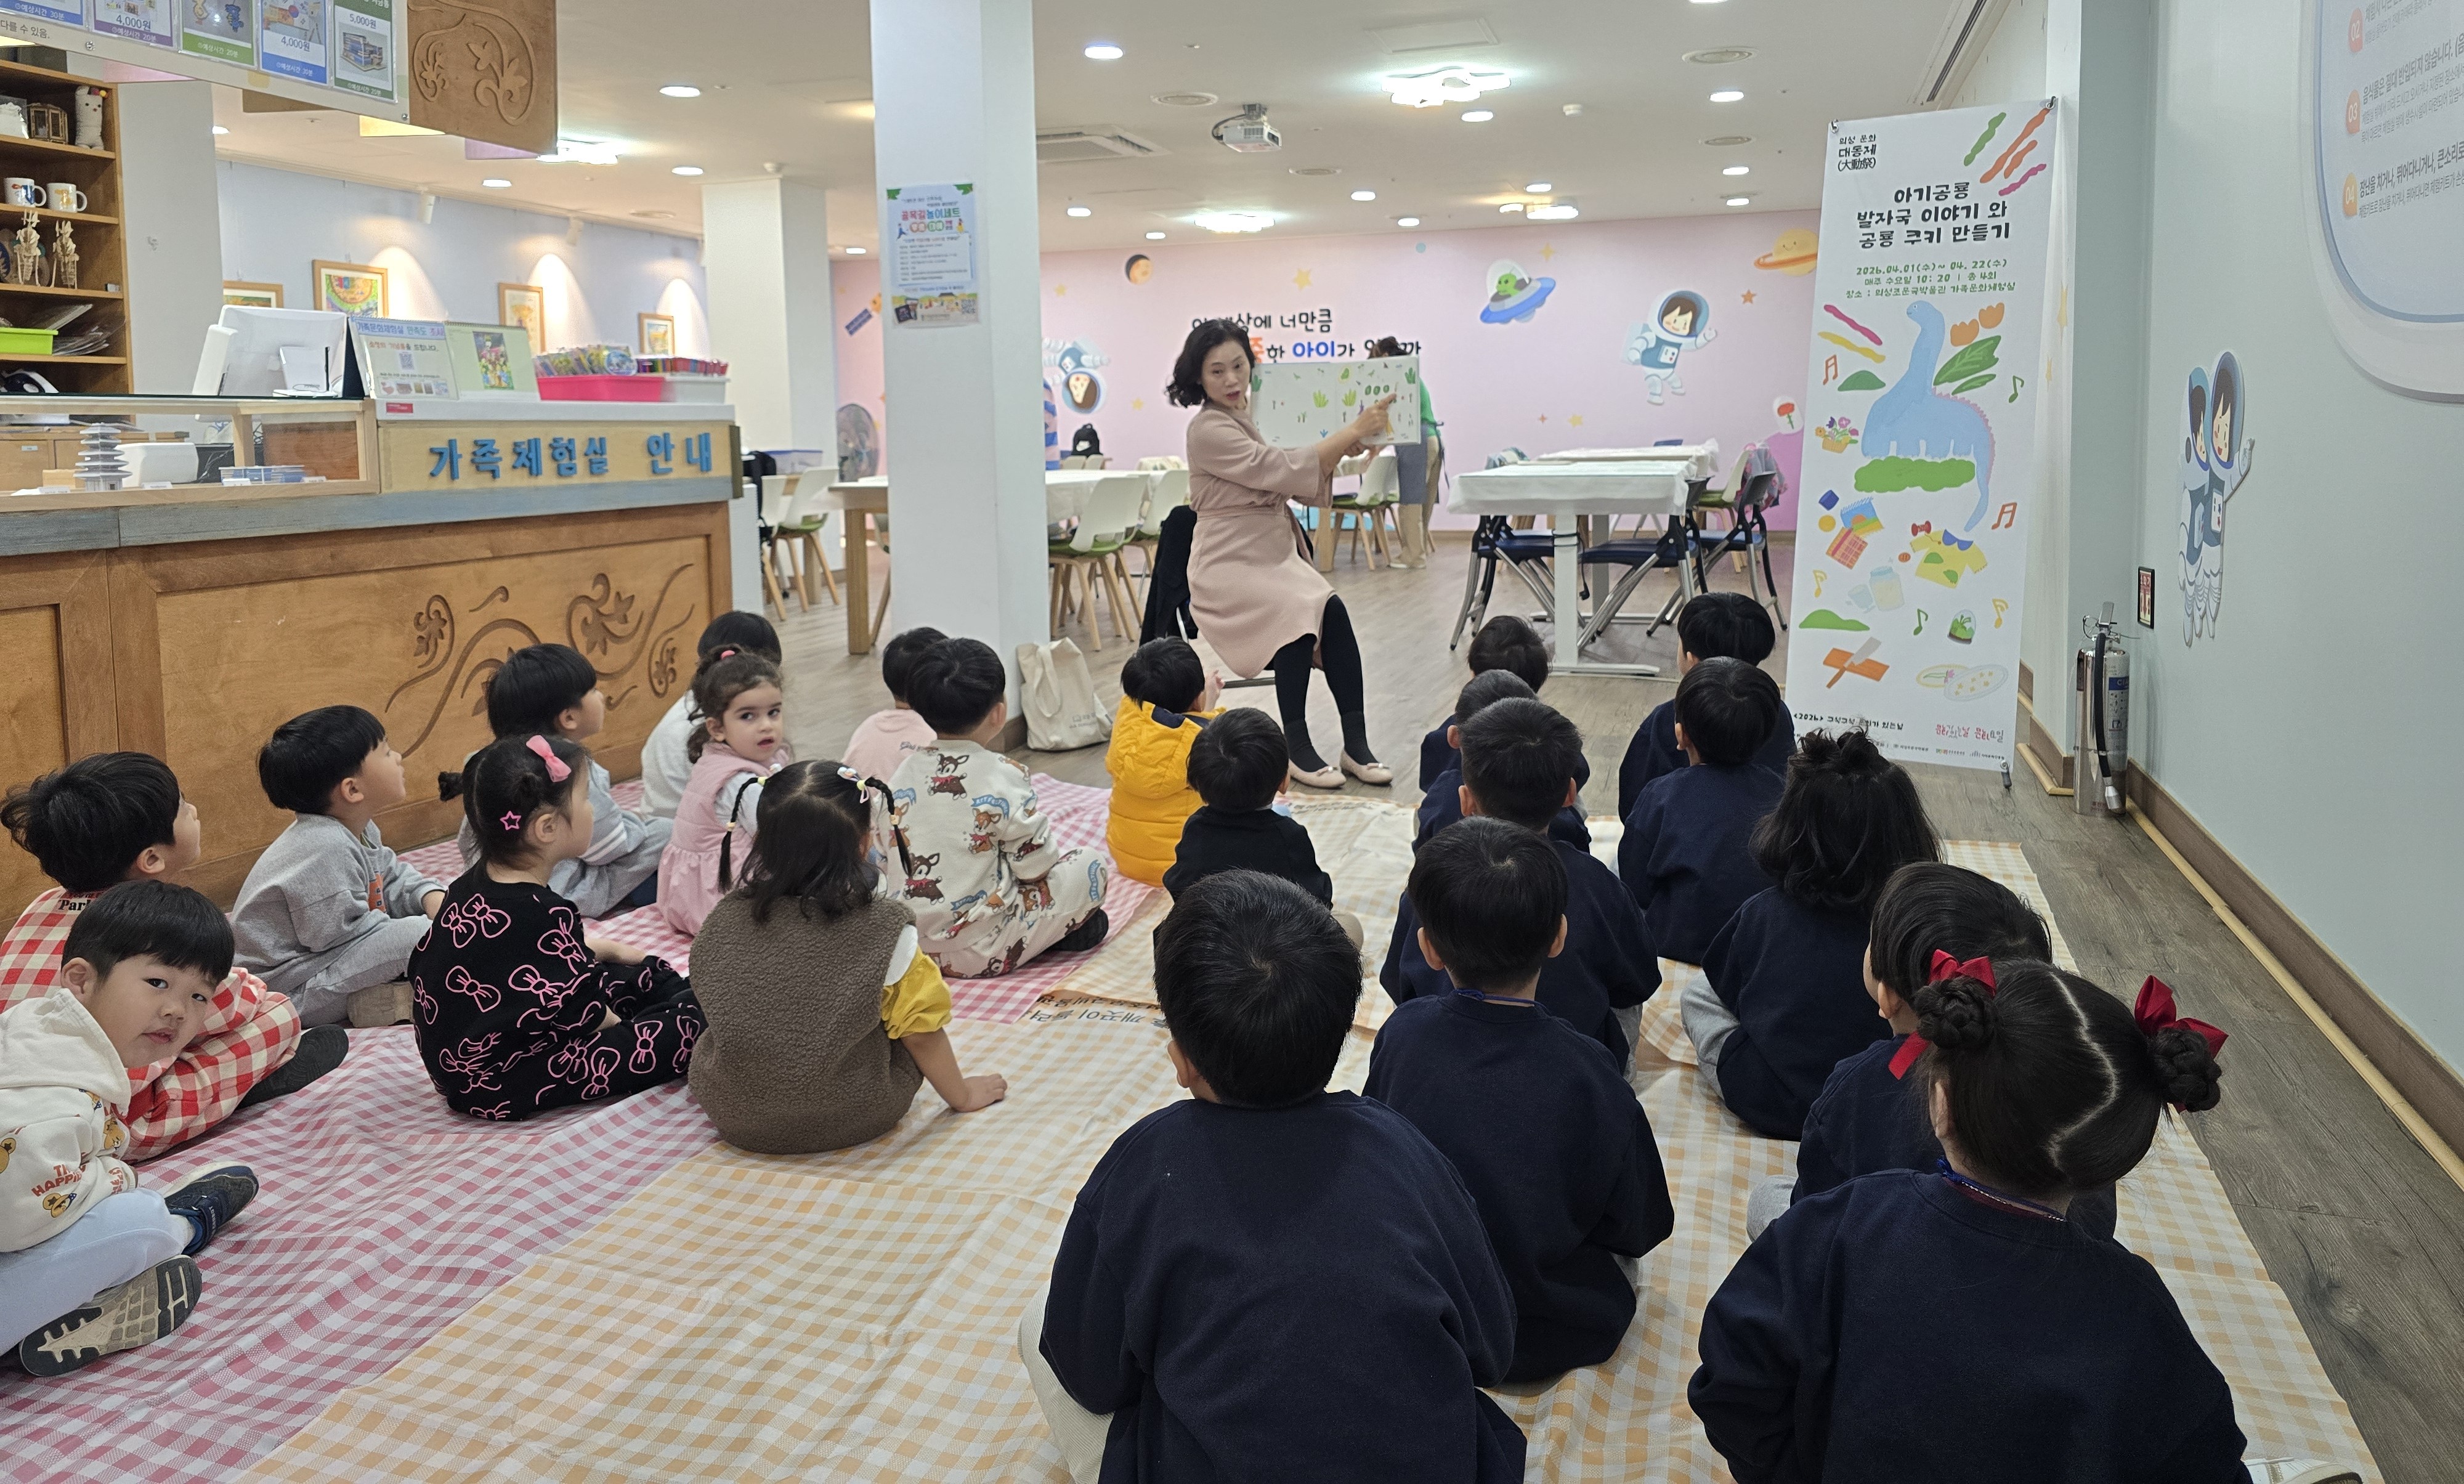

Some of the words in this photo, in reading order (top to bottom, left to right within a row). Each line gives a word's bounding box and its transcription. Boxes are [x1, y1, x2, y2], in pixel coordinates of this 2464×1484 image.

[116, 15, 151, 31] 4,000원
[350, 14, 376, 29] 5,000원
[2351, 20, 2361, 42] 02
[20, 25, 28, 34] 수
[31, 26, 50, 38] 있음.
[281, 36, 310, 52] 4,000원
[2363, 78, 2385, 105] 음식물은
[2386, 68, 2397, 92] 절대
[2399, 54, 2423, 86] 반입되지
[2425, 39, 2453, 71] 않습니다.
[2348, 102, 2357, 123] 03
[1839, 136, 1855, 144] 의성
[1860, 134, 1876, 143] 문화
[1839, 144, 1877, 157] 대동제
[2360, 176, 2375, 198] 장난을
[2377, 168, 2395, 191] 치거나,
[2397, 152, 2436, 186] 뛰어다니거나,
[1894, 182, 1970, 203] 아기공룡
[2345, 186, 2354, 205] 04
[1857, 208, 1912, 229] 발자국
[1921, 204, 1979, 222] 이야기
[1988, 201, 2008, 218] 와
[1859, 230, 1895, 249] 공룡
[1904, 227, 1942, 245] 쿠키
[1952, 222, 2010, 243] 만들기
[1886, 275, 1911, 285] 수요일
[1980, 271, 1996, 280] 4회
[1846, 290, 1862, 298] 장소
[1875, 285, 1947, 297] 의성조문국박물관
[1950, 282, 2016, 294] 가족문화체험실
[1281, 309, 1332, 332] 너만큼
[1292, 341, 1355, 357] 아이가
[430, 437, 609, 480] 가족체험실
[647, 432, 712, 474] 안내
